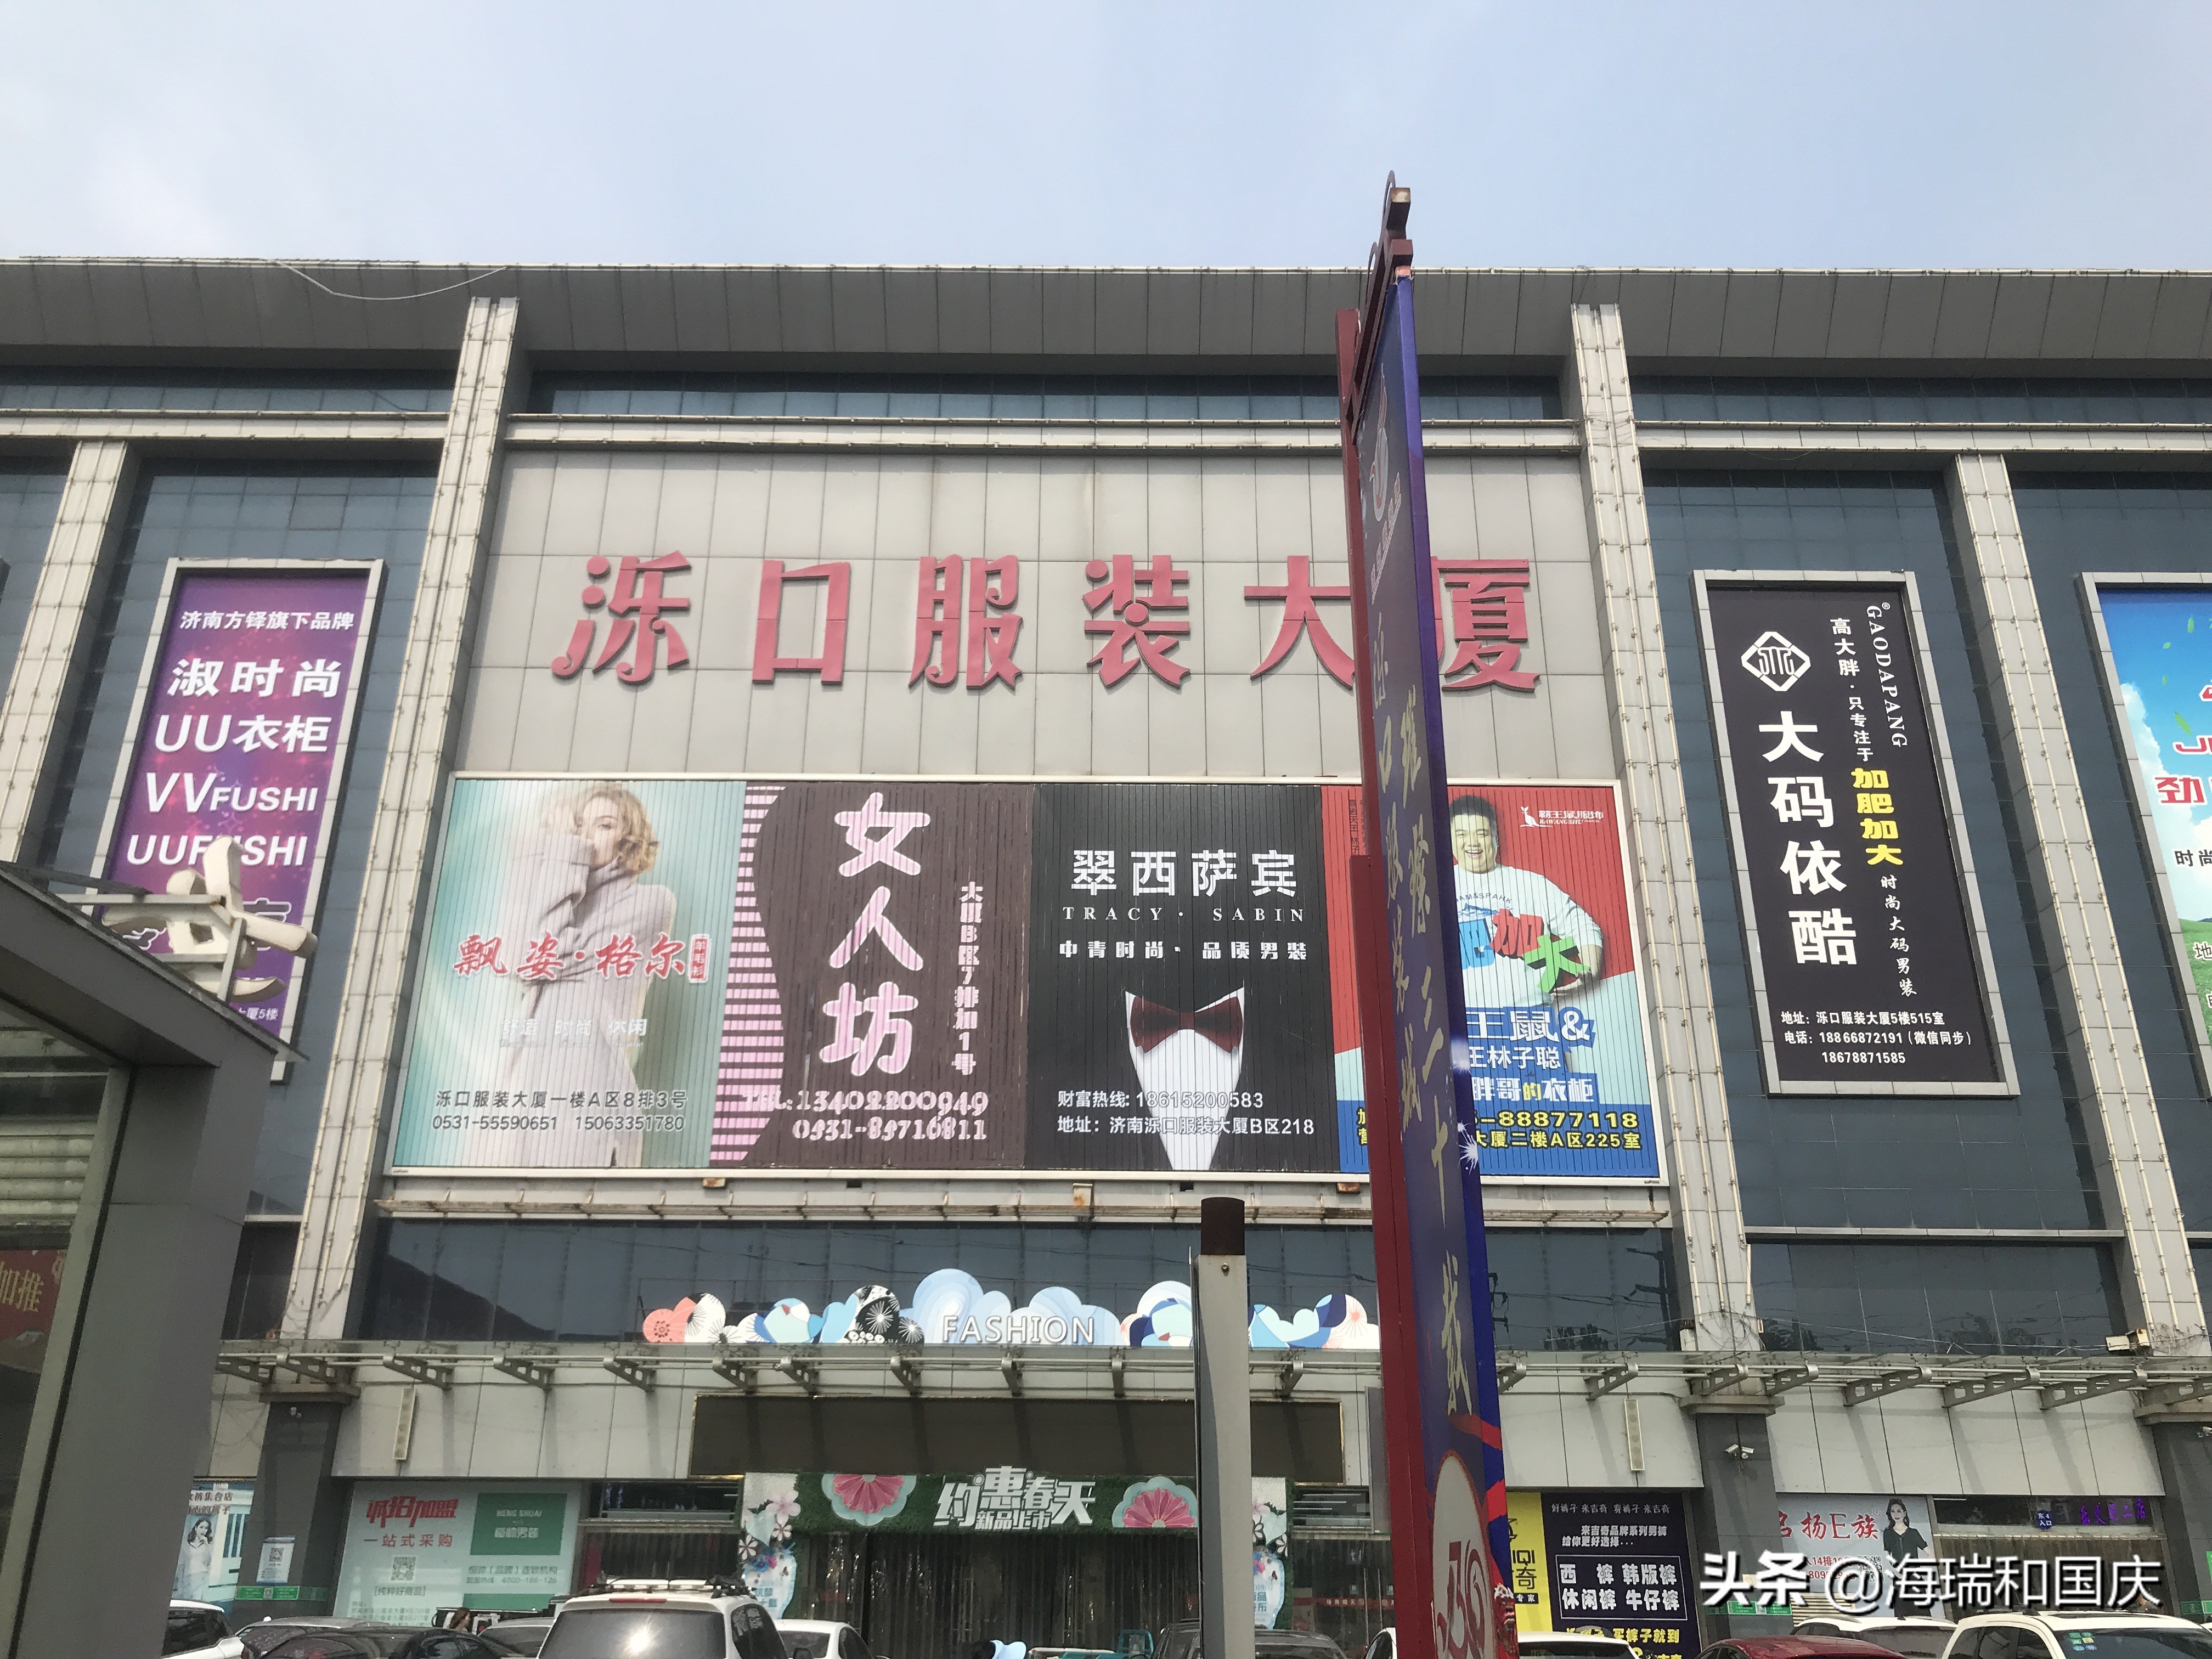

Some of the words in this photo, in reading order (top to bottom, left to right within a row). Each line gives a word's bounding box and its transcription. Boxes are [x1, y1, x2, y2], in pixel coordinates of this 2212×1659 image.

[550, 550, 1543, 695] 泺口服装大厦
[167, 658, 341, 698] 淑时尚
[1866, 605, 1908, 748] GAODAPANG
[154, 715, 331, 753] UU衣柜
[145, 771, 318, 814] VVFUSHI
[2155, 777, 2212, 803] 劲
[1758, 709, 1858, 967] 大码依酷
[127, 834, 308, 866] UUFSHI
[1071, 849, 1297, 898] 翠西萨宾
[1850, 767, 1904, 866] 加肥加大
[1880, 874, 1917, 997] 时尚大码男装
[1212, 907, 1305, 922] SABIN
[820, 792, 932, 1076] 女人坊
[555, 1018, 592, 1036] 时尚
[606, 1018, 648, 1036] 休闲
[1816, 1011, 1945, 1025] 泺口服装大厦5楼515室
[1821, 1052, 1906, 1064] 18678871585
[436, 1090, 687, 1109] 泺口服装大厦一楼A区8排3号
[1136, 1092, 1264, 1108] 18615200583
[432, 1115, 558, 1131] 0531-55590651
[575, 1115, 686, 1132] 15063351780
[1109, 1117, 1314, 1136] 济南泺口服装大厦B区218
[1475, 1111, 1638, 1128] -88877118
[941, 1315, 1095, 1344] FASHION
[933, 1465, 1096, 1527] 约惠春天
[974, 1509, 1052, 1530] 新品上市
[363, 1533, 453, 1548] 一站式采购
[1581, 1525, 1668, 1537] 来吉奇品牌系列男裤
[1622, 1564, 1677, 1585] 韩版裤
[1516, 1593, 1536, 1602] 专家
[1562, 1588, 1617, 1610] 休闲裤
[1626, 1589, 1680, 1611] 牛仔裤
[1612, 1628, 1680, 1643] 买裤子就到
